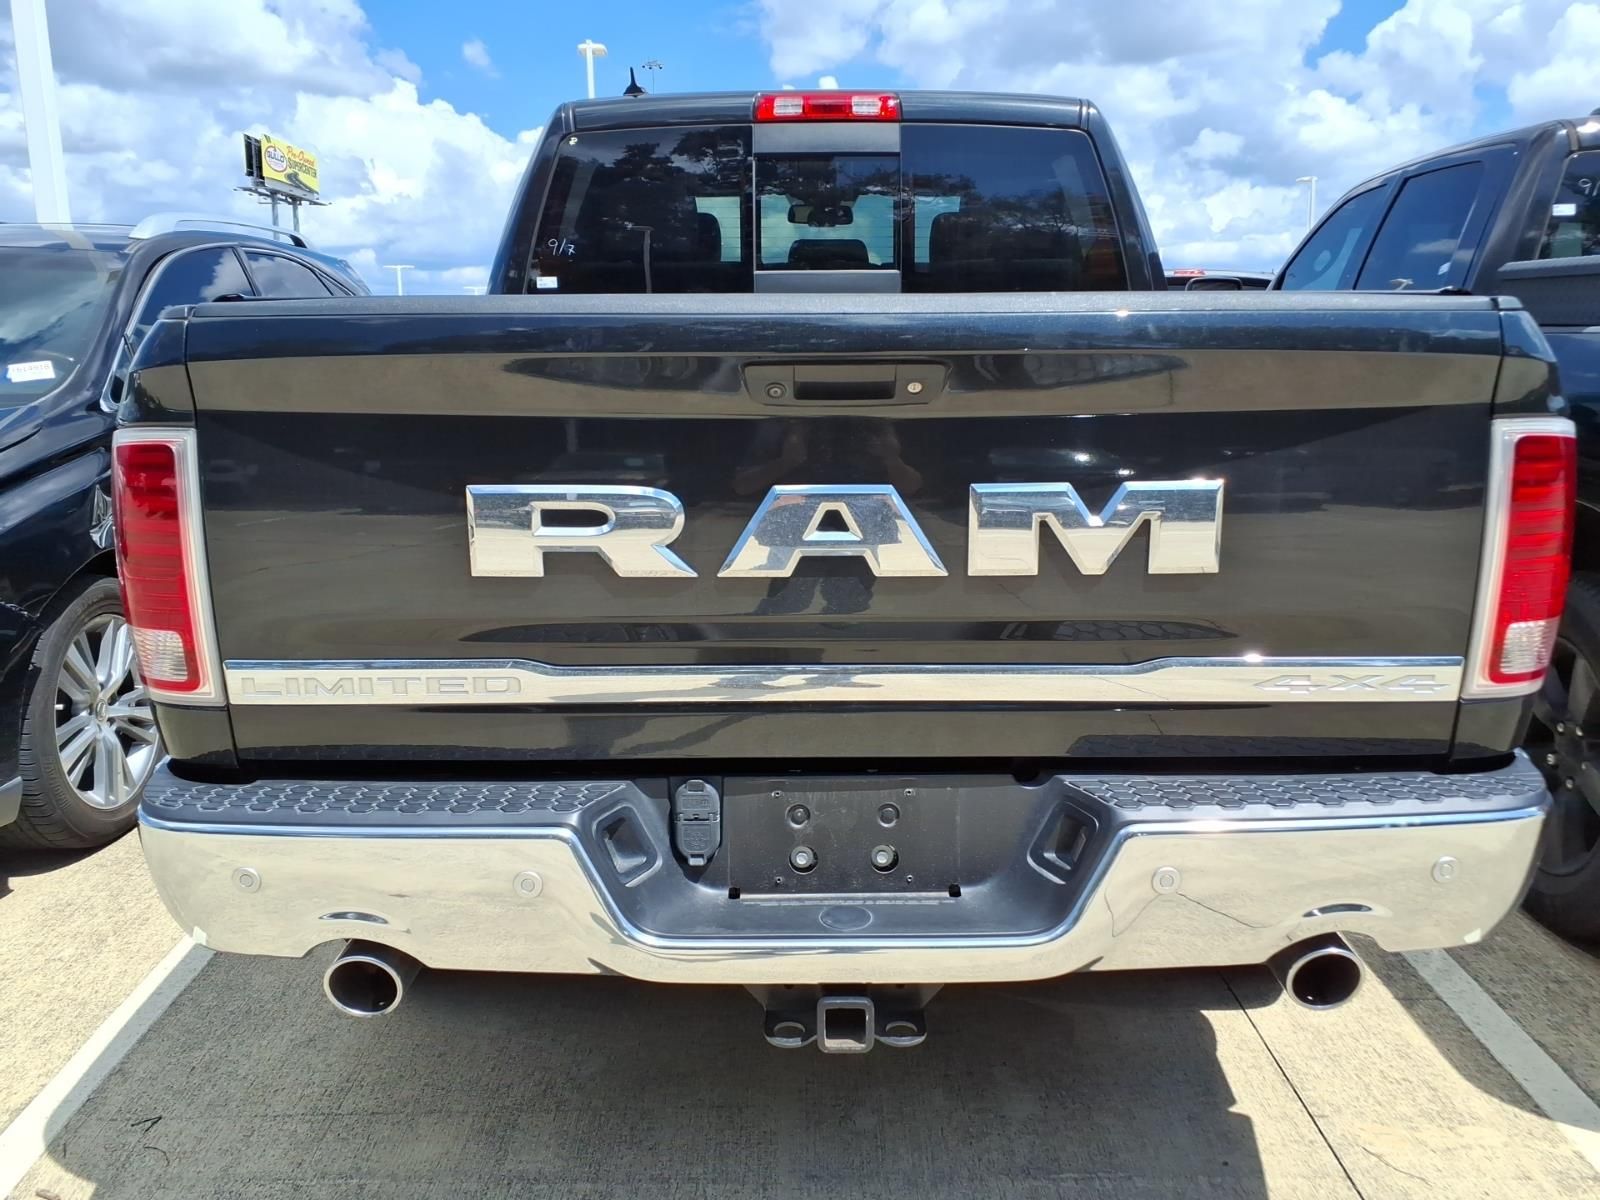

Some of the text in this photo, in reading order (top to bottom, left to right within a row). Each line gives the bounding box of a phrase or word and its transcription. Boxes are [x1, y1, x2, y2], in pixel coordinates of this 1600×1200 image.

[547, 237, 576, 256] 9/7
[465, 478, 1225, 578] RAM
[240, 676, 522, 697] LIMITED
